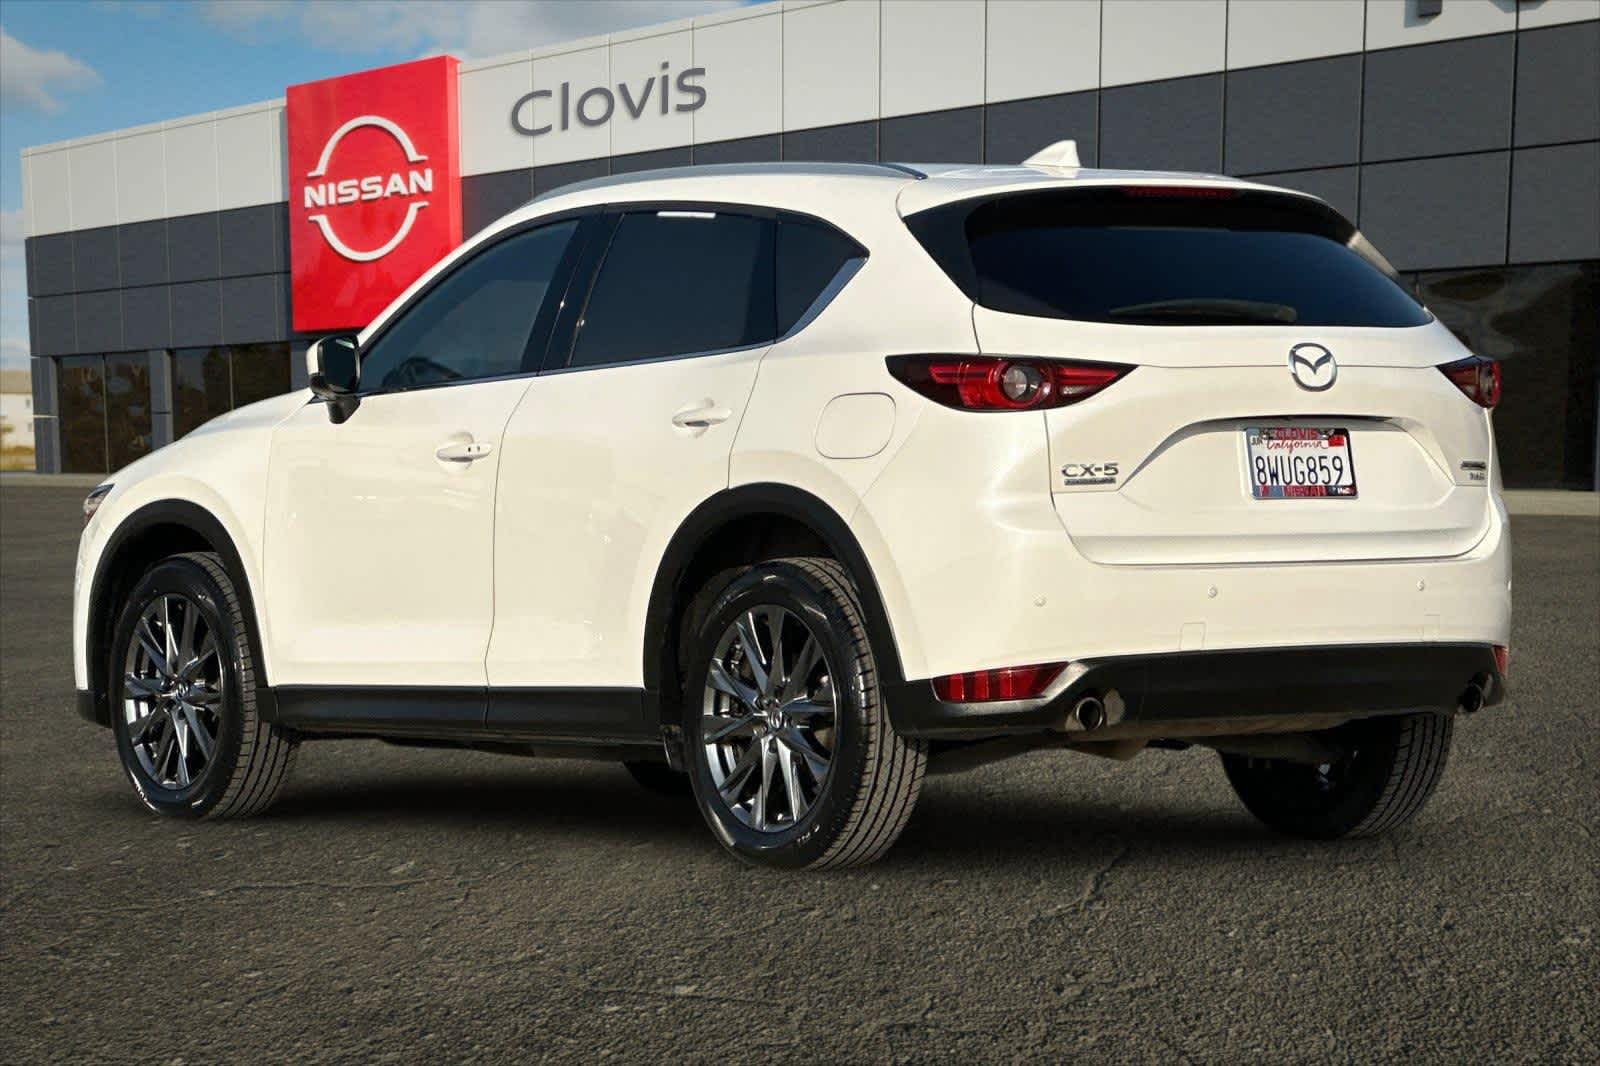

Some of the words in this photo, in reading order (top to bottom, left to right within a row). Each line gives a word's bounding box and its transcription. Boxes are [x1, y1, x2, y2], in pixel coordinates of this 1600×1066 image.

[511, 62, 707, 136] Clovis
[304, 169, 433, 209] NISSAN
[1061, 462, 1119, 478] CX-5
[1255, 455, 1343, 486] 8WUG859
